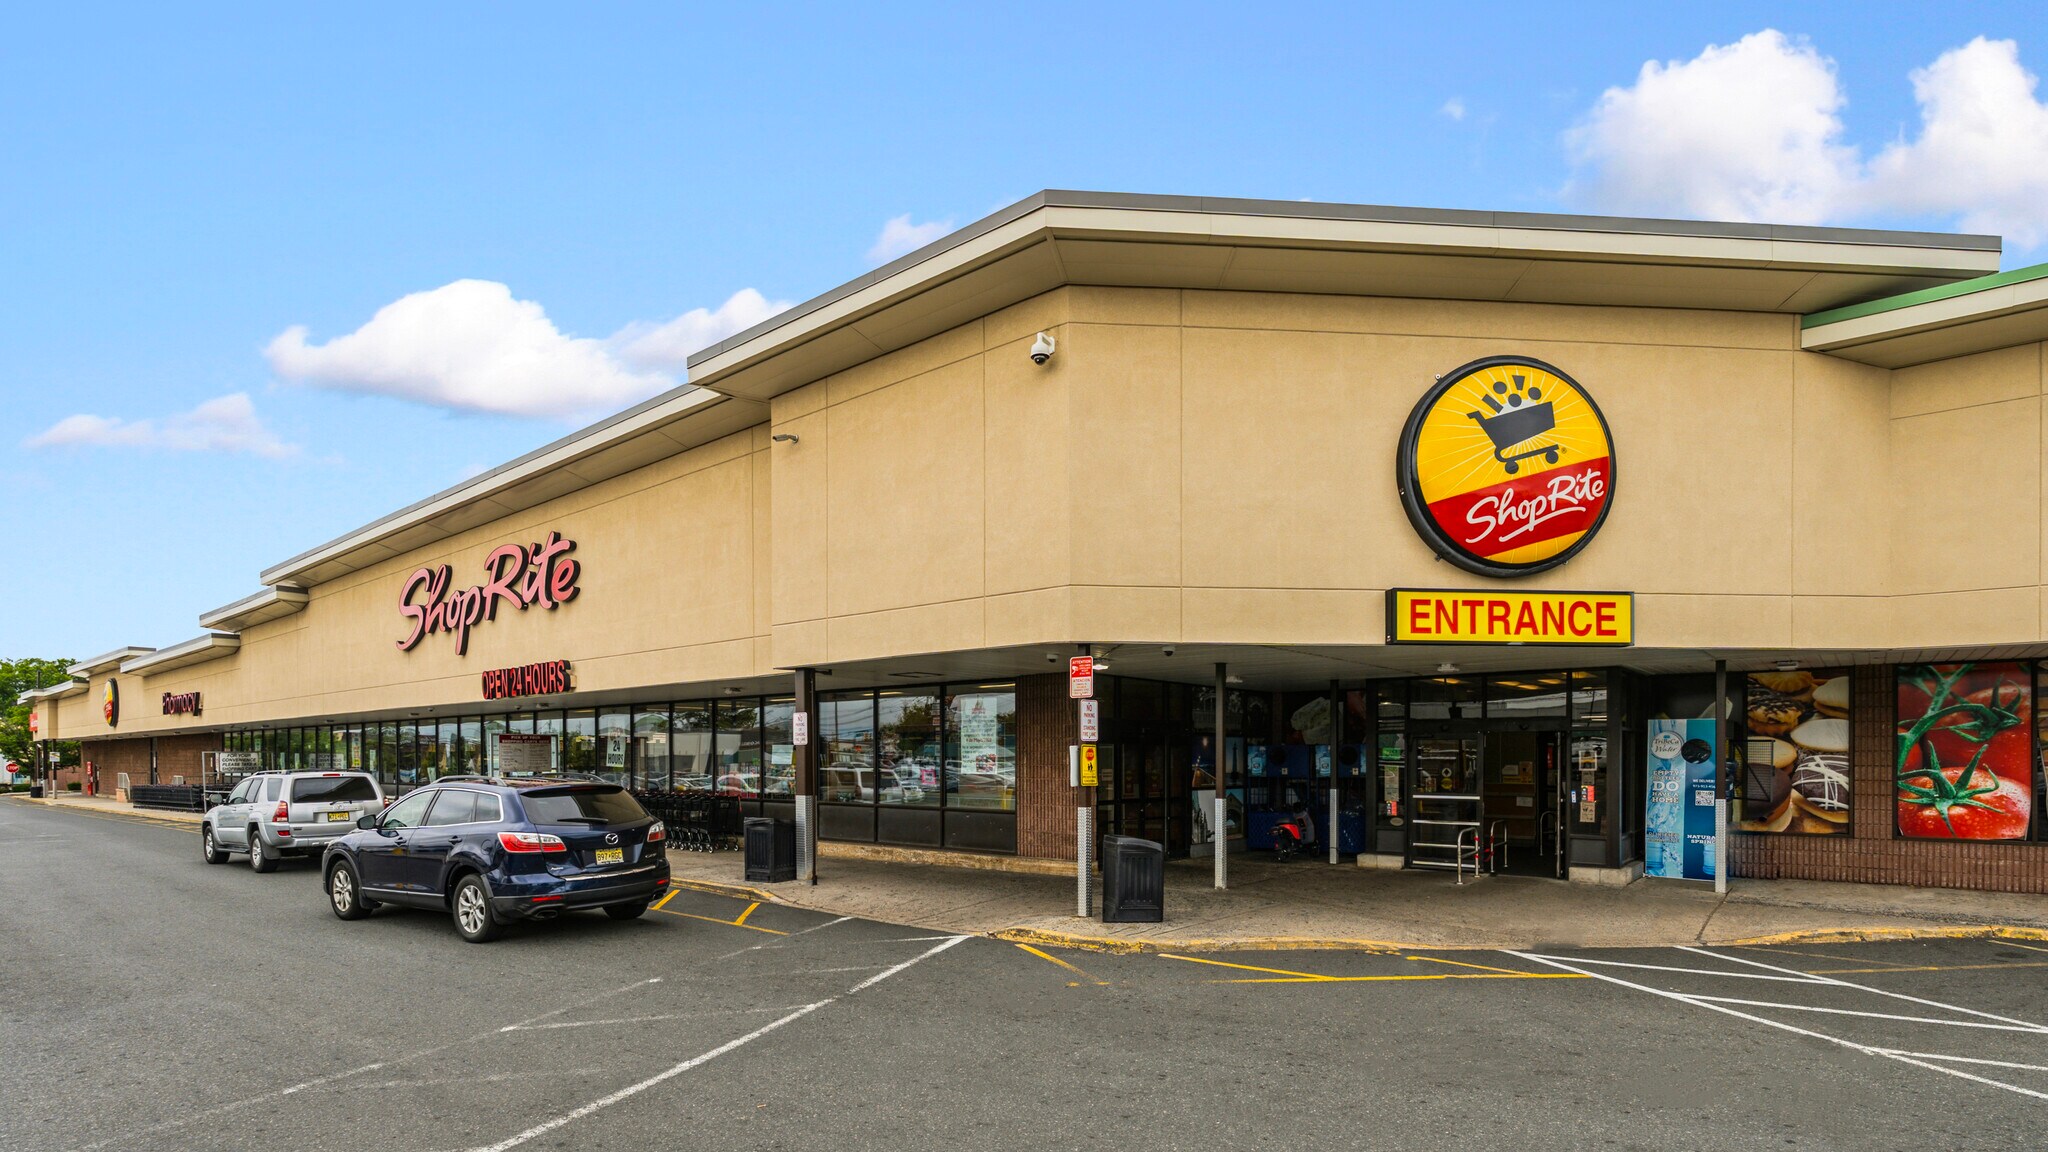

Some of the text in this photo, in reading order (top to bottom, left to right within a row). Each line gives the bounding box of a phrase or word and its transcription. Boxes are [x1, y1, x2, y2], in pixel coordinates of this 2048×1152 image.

[1465, 468, 1605, 543] ShopRite
[396, 531, 581, 656] ShopRite
[1410, 599, 1617, 637] ENTRANCE
[481, 659, 569, 700] OPEN 24 HOURS
[162, 691, 201, 717] Pharmacy
[608, 753, 624, 765] HOURS
[612, 740, 621, 752] 24
[1652, 780, 1679, 791] DO
